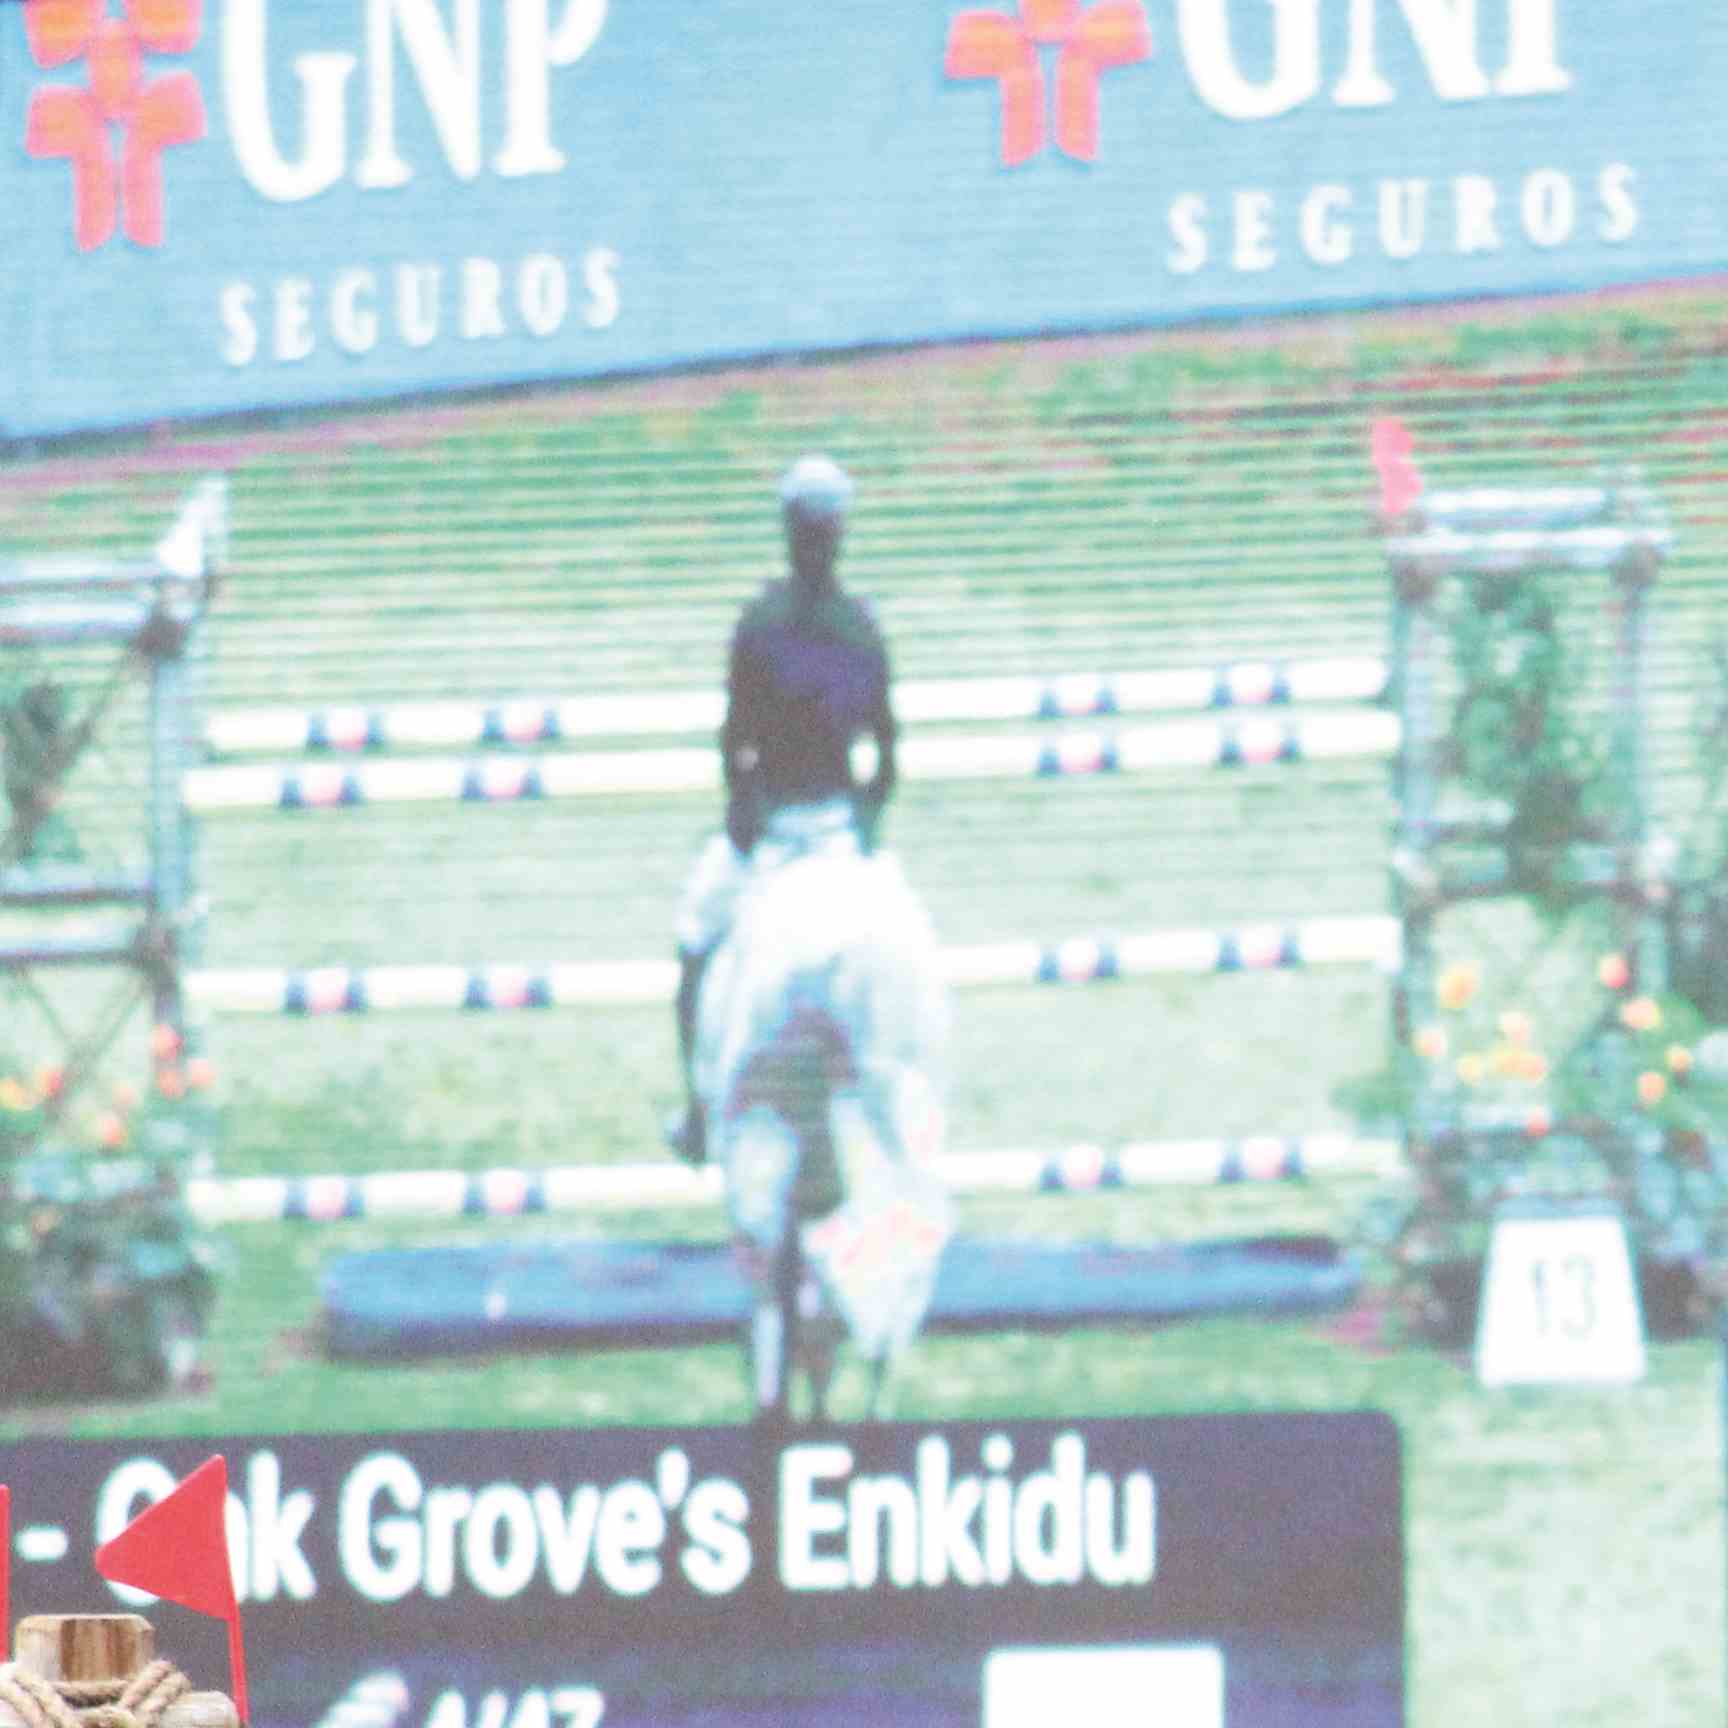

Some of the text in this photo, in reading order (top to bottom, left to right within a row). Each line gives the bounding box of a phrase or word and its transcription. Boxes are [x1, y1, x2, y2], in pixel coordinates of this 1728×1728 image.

[1166, 160, 1640, 274] SEGUROS
[220, 247, 621, 366] SEGUROS
[97, 1453, 316, 1606] Ok
[340, 1447, 751, 1602] Grove's
[780, 1431, 1157, 1591] Enkidu
